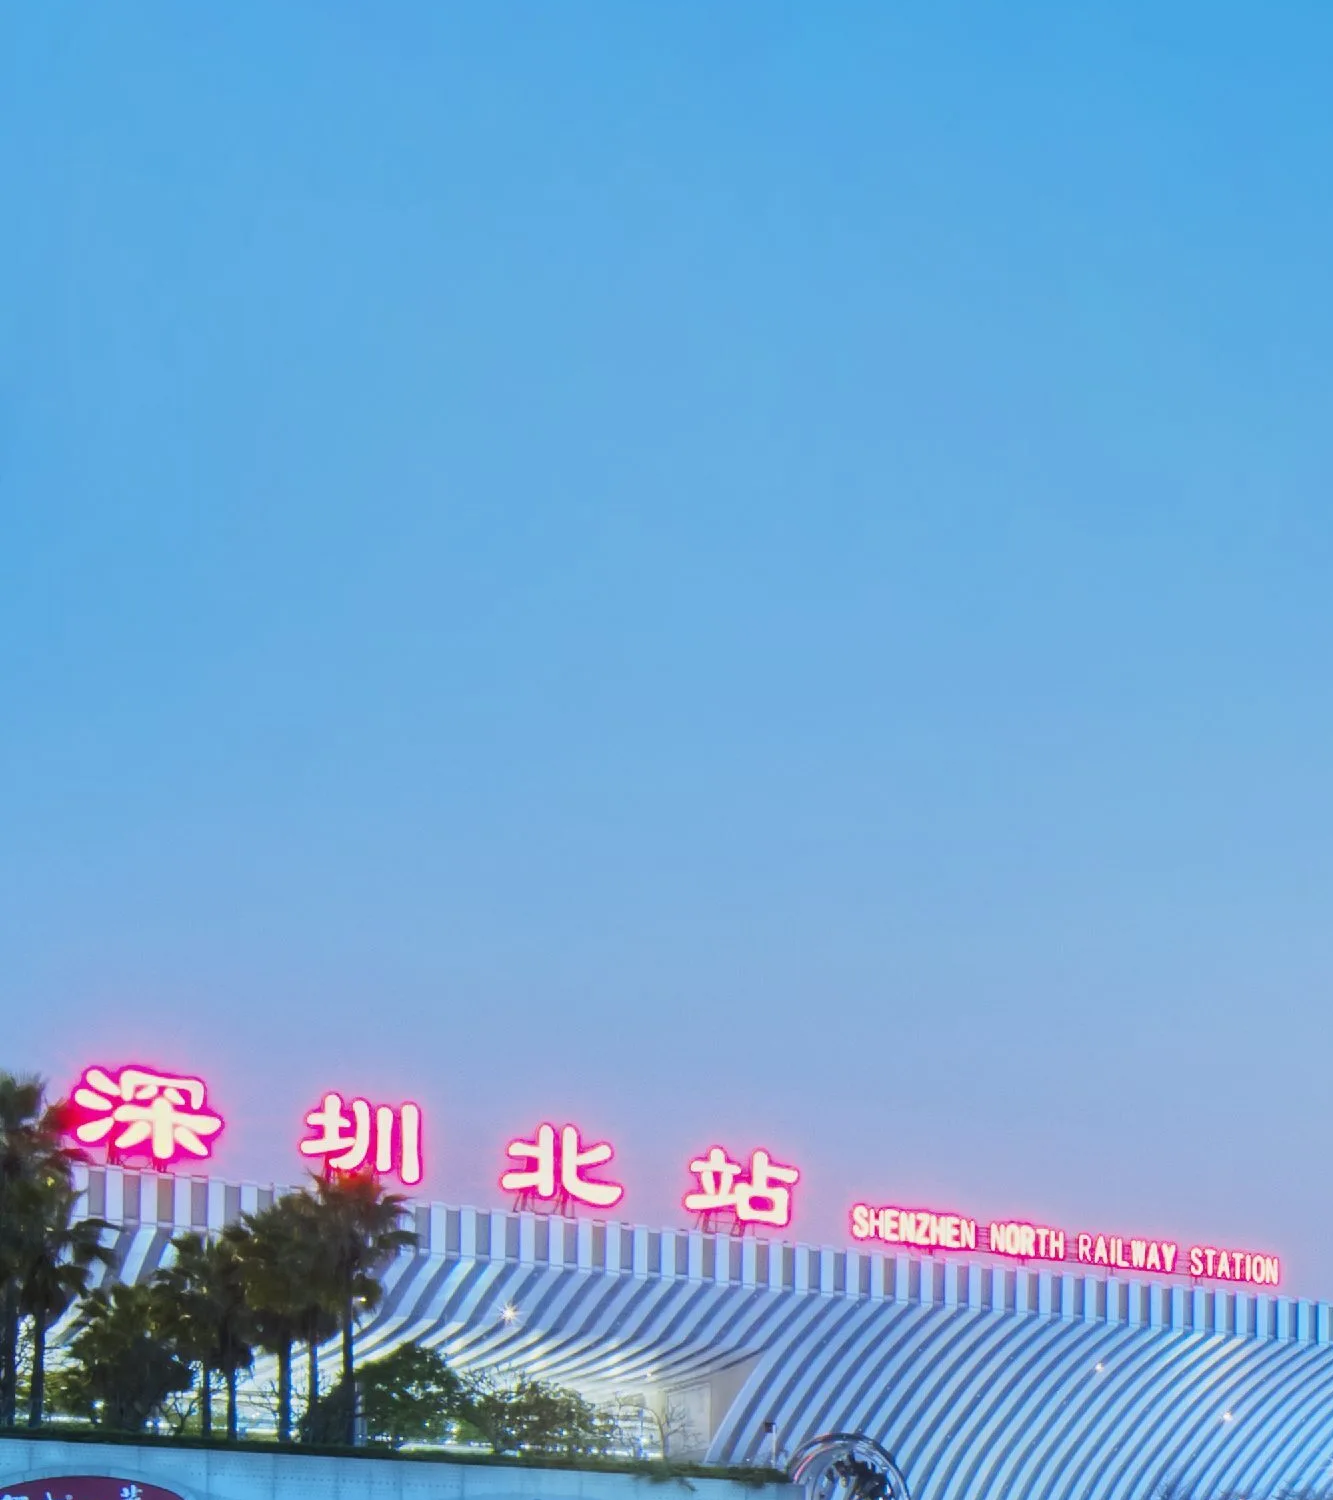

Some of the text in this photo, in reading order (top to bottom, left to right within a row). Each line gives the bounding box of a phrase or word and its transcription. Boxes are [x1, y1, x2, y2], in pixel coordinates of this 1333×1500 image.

[73, 1066, 800, 1228] 深圳北站
[852, 1203, 1280, 1286] SHENZHEN NORTH RAILWAY STATION
